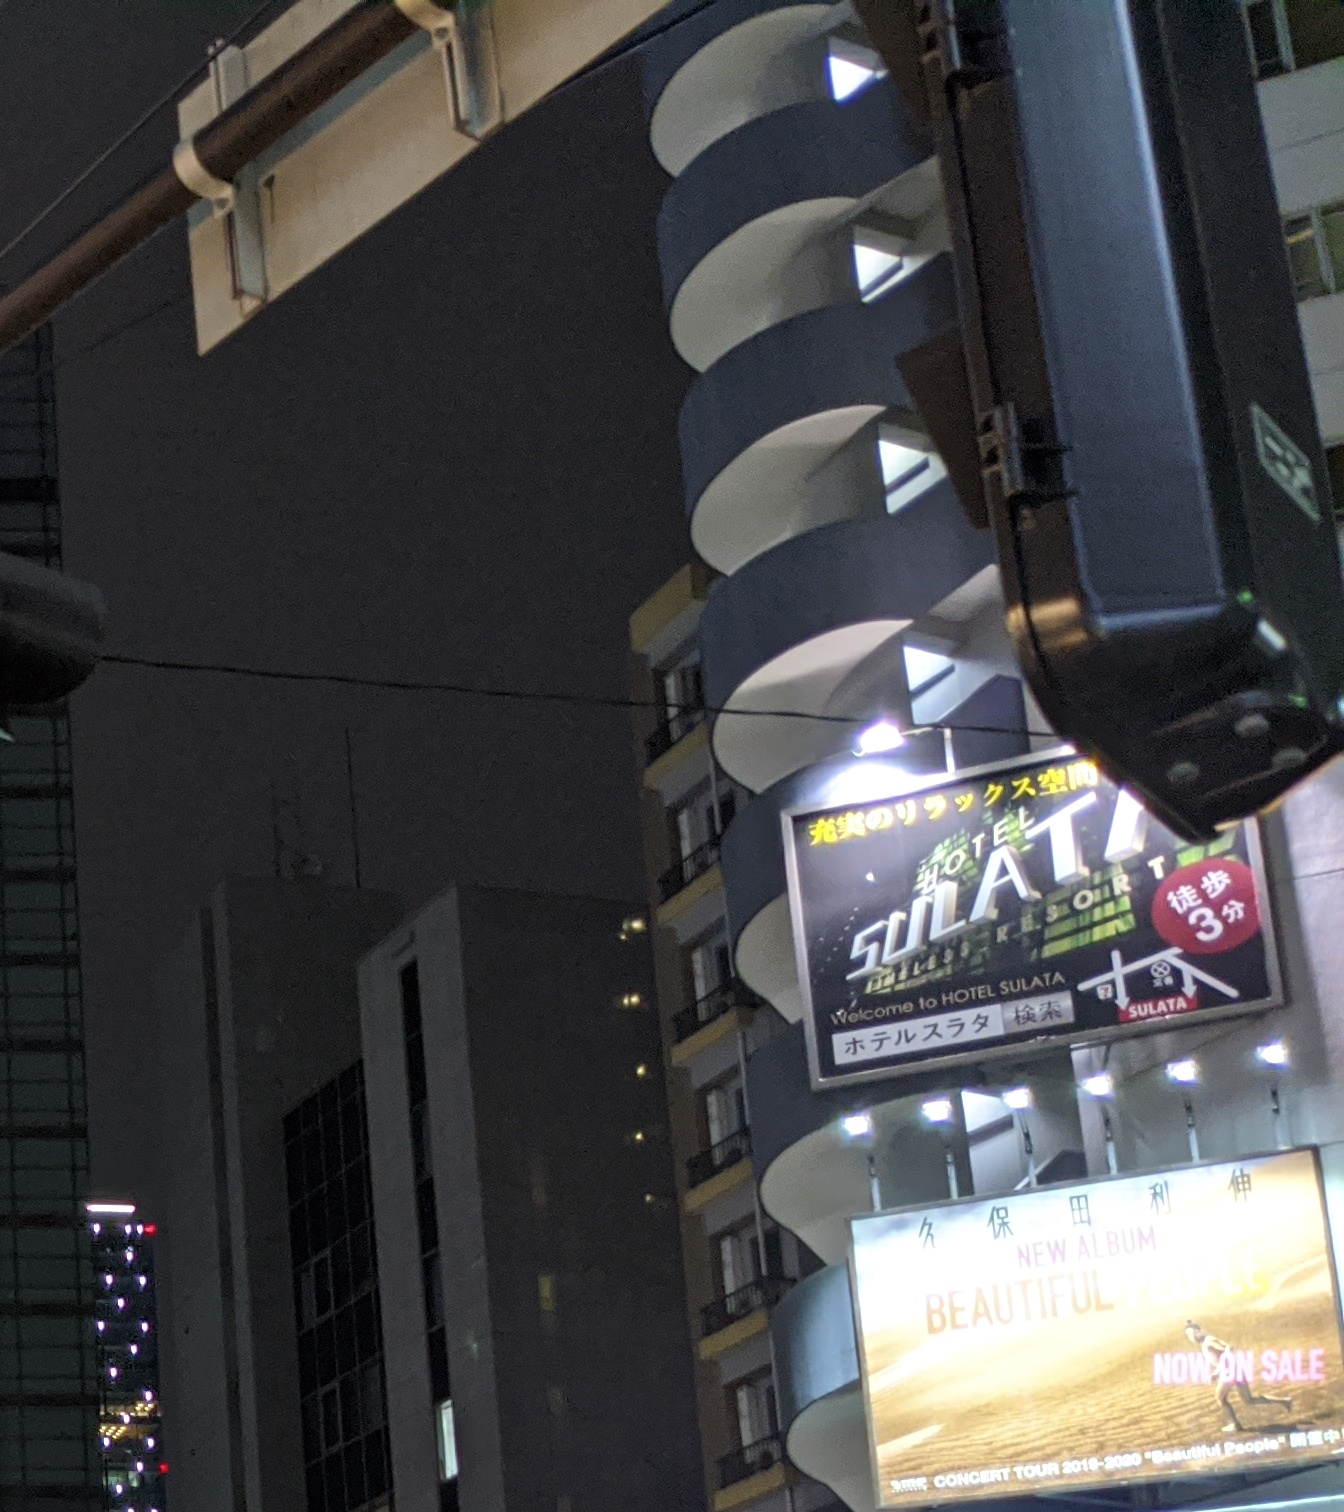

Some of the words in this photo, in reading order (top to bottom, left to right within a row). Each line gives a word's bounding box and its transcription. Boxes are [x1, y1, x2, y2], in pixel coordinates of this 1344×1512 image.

[809, 761, 1099, 846] 充実のリラックス空間
[921, 804, 1035, 895] HOTEL
[1167, 870, 1231, 915] 徒歩
[1188, 900, 1245, 942] 3分
[830, 1001, 914, 1027] Welcome
[919, 996, 938, 1011] to
[942, 984, 996, 1006] HOTEL
[999, 971, 1066, 996] SULATA
[1013, 1001, 1062, 1027] 検索
[1128, 996, 1187, 1018] SULATA
[844, 1013, 990, 1056] ホテルスラタ
[917, 1166, 1253, 1250] 久保田利伸
[1017, 1238, 1067, 1270] NEW
[1077, 1225, 1157, 1262] ALBUM
[925, 1270, 1115, 1335] BEAUTIFUL
[1154, 1352, 1212, 1385] NOW
[1219, 1350, 1255, 1383] ON
[1260, 1348, 1326, 1382] SALE
[934, 1467, 1011, 1488] CONCERT
[1013, 1461, 1060, 1479] TOUR
[1062, 1452, 1142, 1474] 2019-2020
[1289, 1428, 1344, 1448] 開催中
